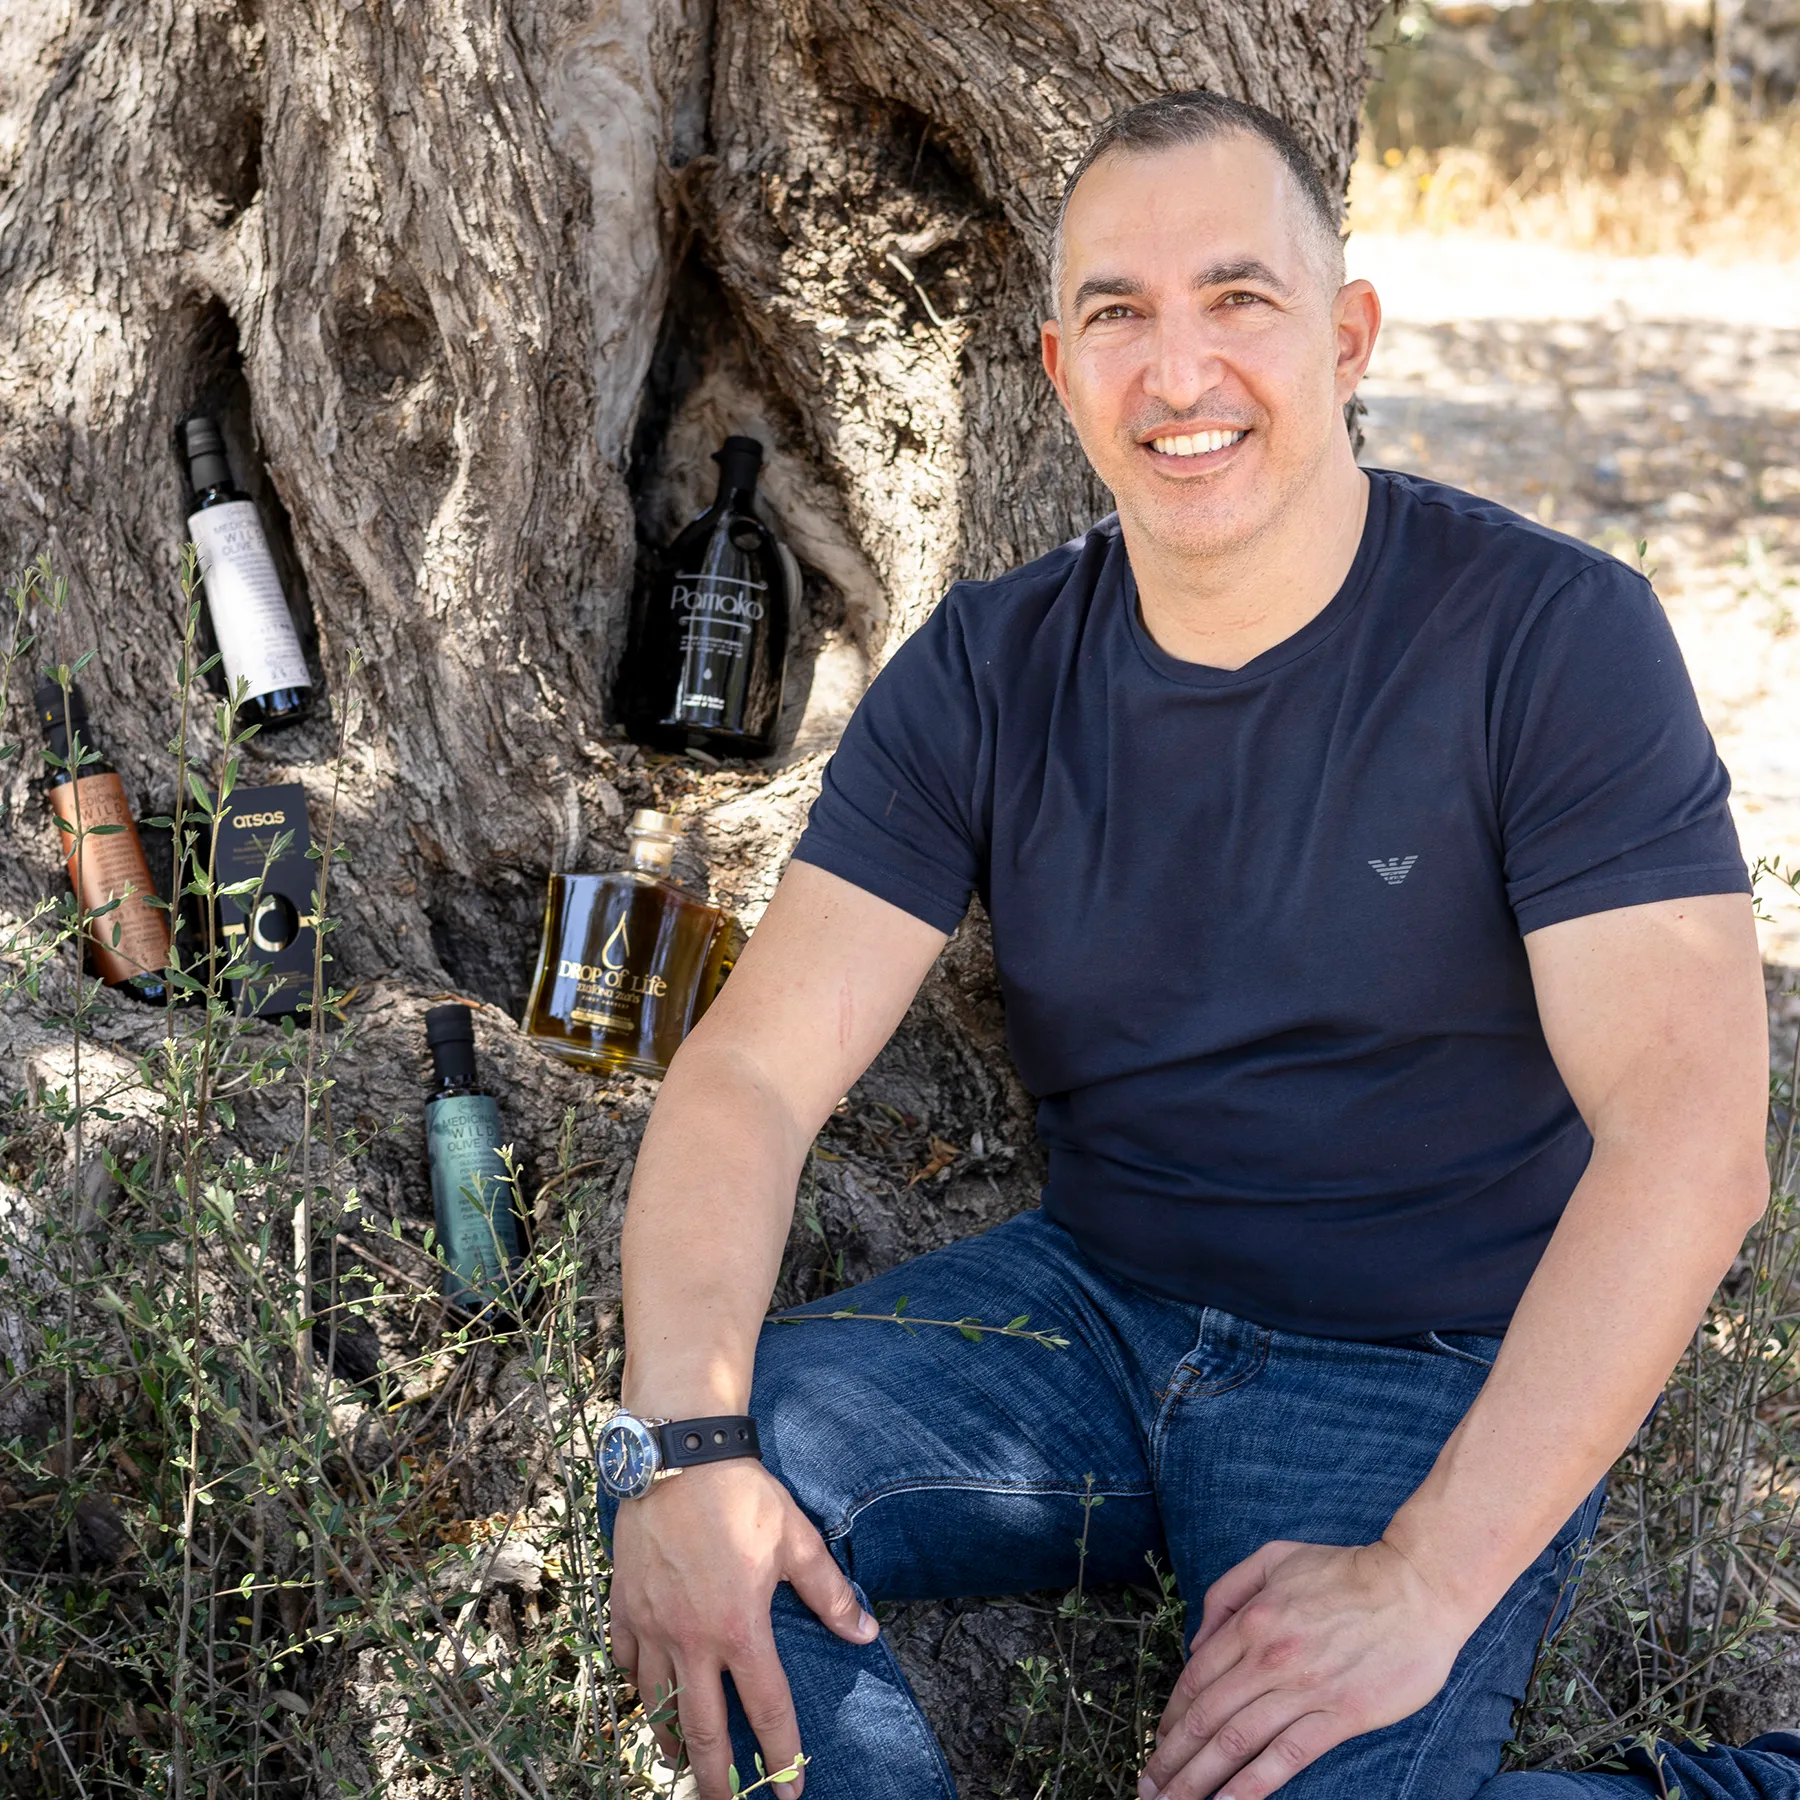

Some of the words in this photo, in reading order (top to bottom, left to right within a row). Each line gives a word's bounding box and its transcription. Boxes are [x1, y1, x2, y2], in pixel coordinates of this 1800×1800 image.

[670, 585, 764, 620] Pamako
[80, 802, 123, 820] WILD
[232, 810, 286, 829] atsas
[558, 960, 603, 983] DROP
[630, 973, 667, 997] Life
[451, 1125, 495, 1140] WILD
[447, 1138, 481, 1152] OLIVE
